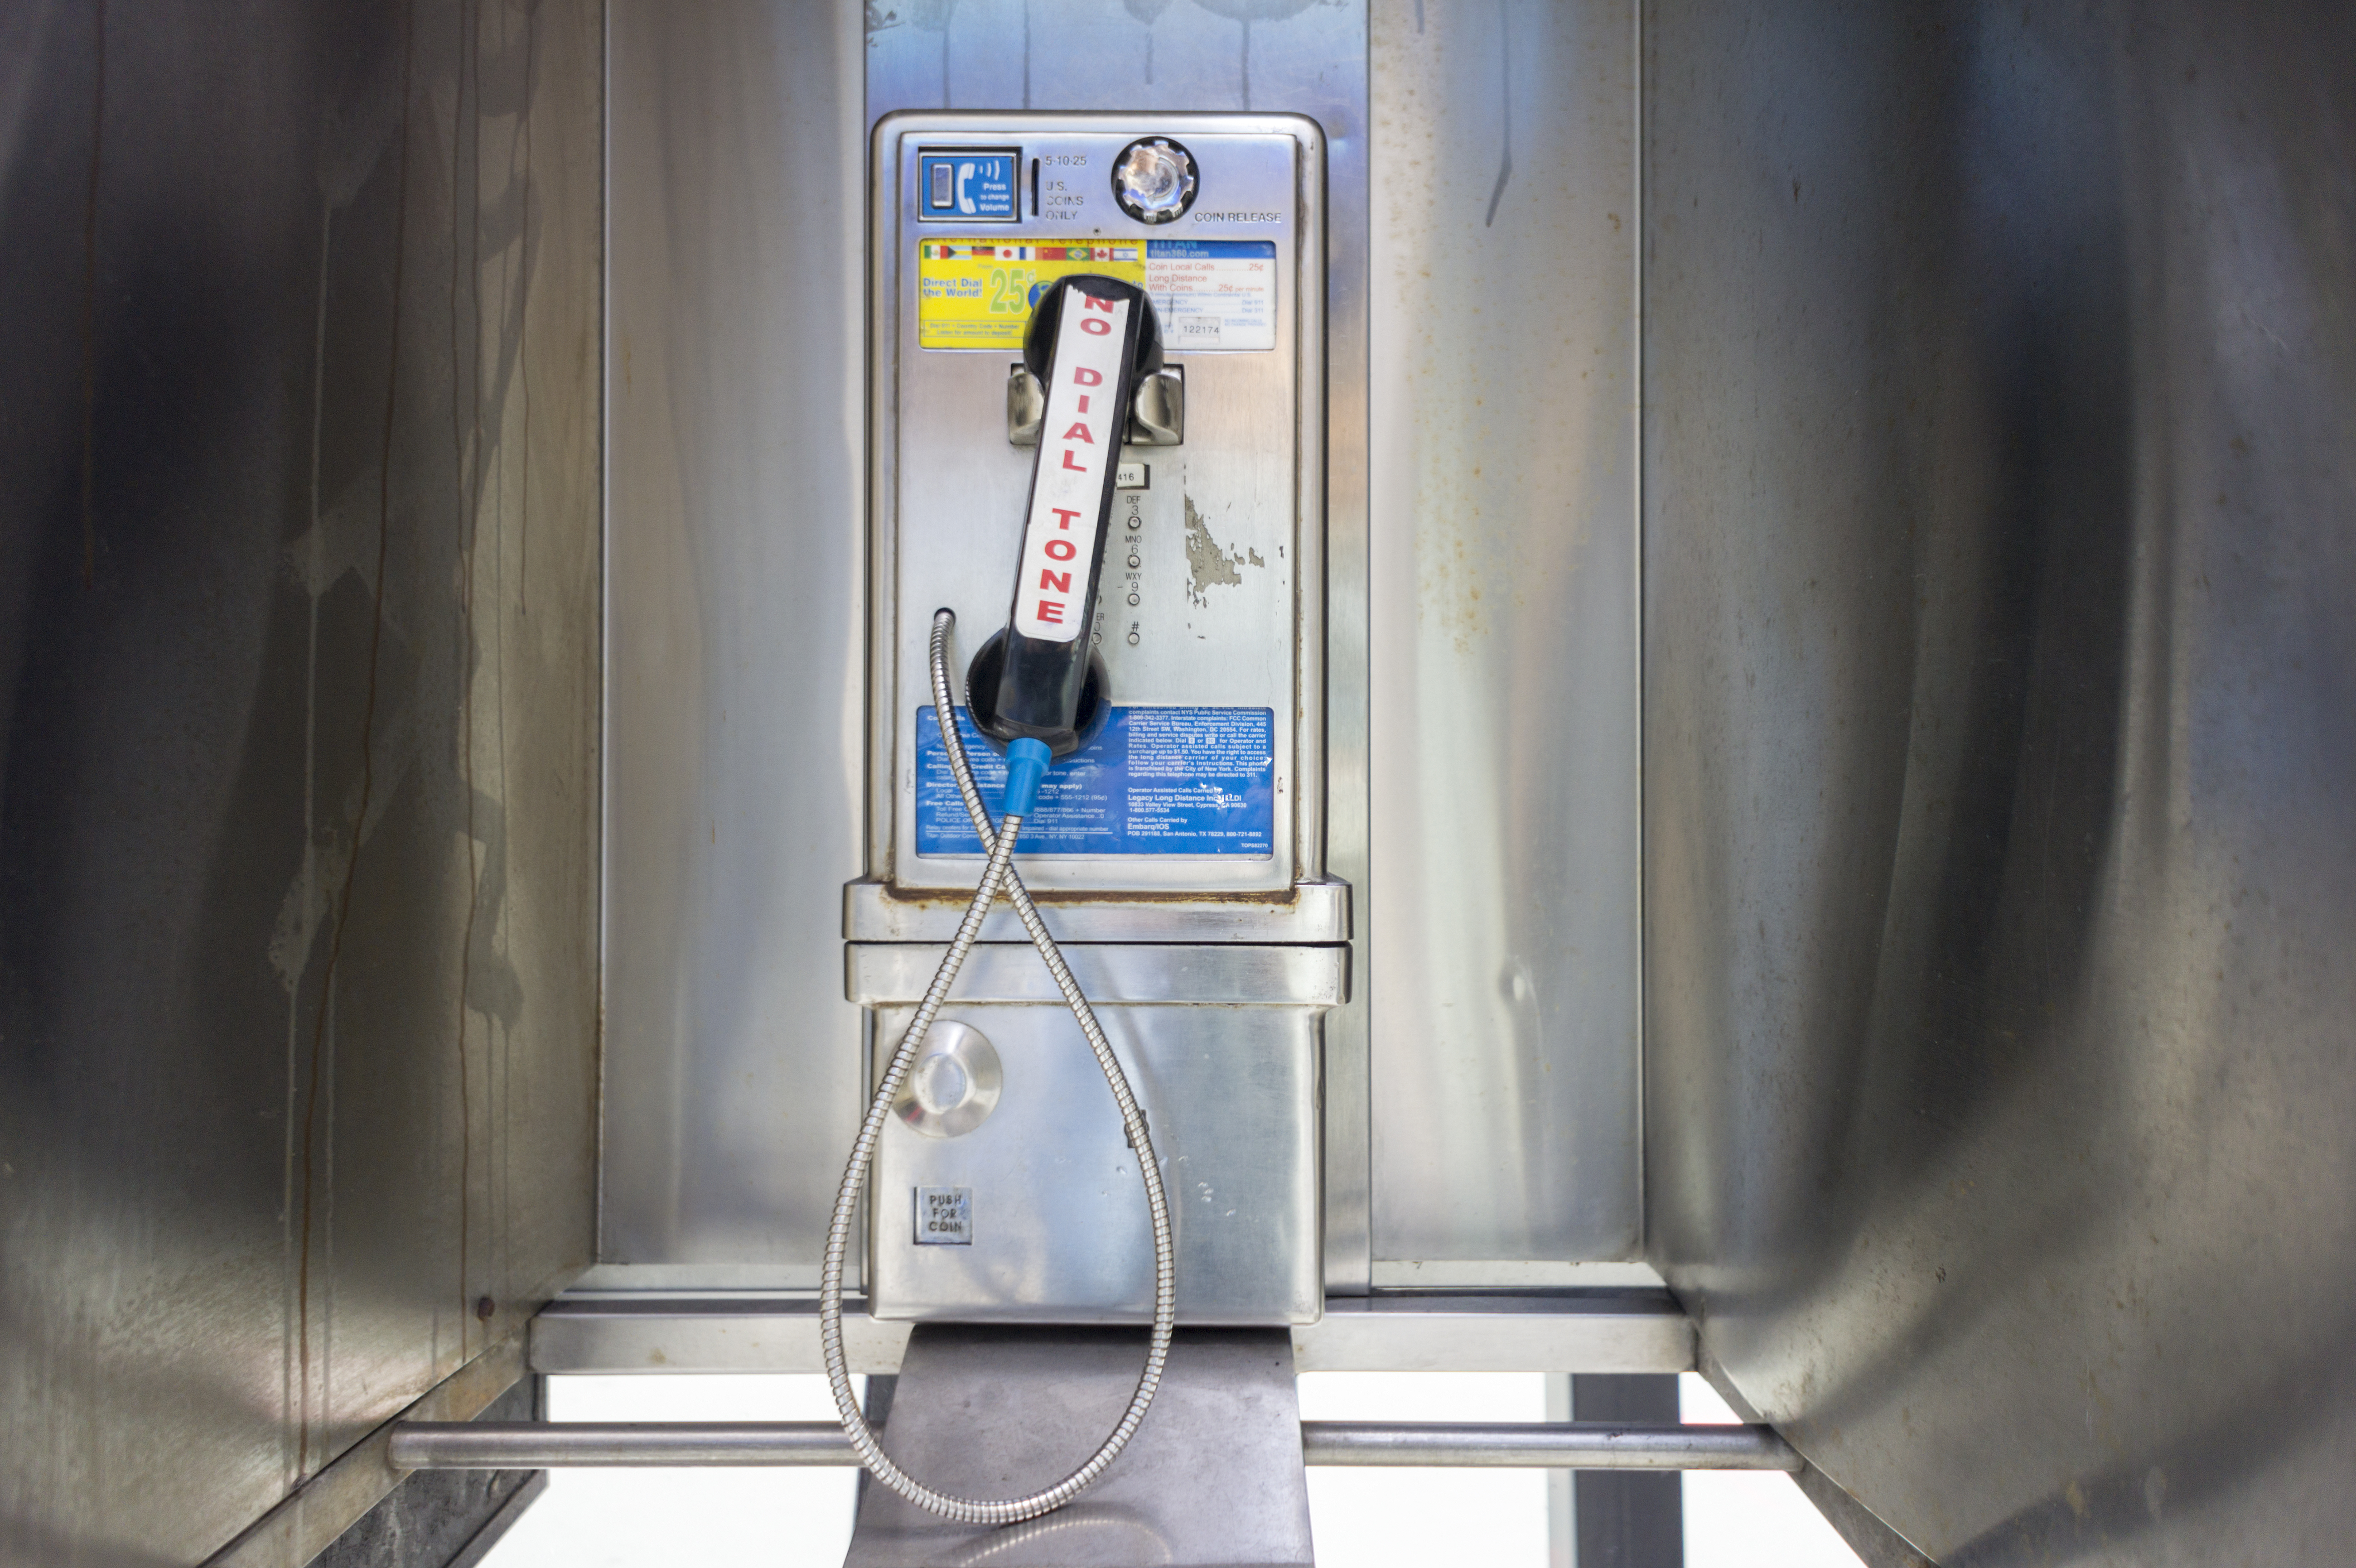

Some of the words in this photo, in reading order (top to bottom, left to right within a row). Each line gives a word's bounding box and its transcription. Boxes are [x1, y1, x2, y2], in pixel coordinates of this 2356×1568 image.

[1046, 182, 1067, 191] U.S.
[1046, 197, 1084, 205] COINS
[1046, 211, 1078, 220] ONLY
[1195, 213, 1224, 222] COIN
[1228, 213, 1282, 223] RELEASE
[1195, 263, 1215, 271] Calls
[923, 278, 956, 287] Direct
[961, 278, 982, 287] Dial
[1149, 275, 1169, 284] Long
[923, 288, 942, 297] the
[946, 288, 983, 297] World!
[1183, 325, 1219, 334] 122174
[1062, 366, 1103, 473] DIAL
[1127, 496, 1141, 504] DEF
[1132, 505, 1139, 516] 3
[1125, 535, 1142, 543] MNO
[1131, 544, 1139, 554] 6
[1037, 507, 1081, 624] TONE
[1125, 572, 1142, 580] WXY
[1131, 582, 1139, 592] 9
[929, 1194, 962, 1206] PUSH
[932, 1208, 957, 1219] FOR
[929, 1221, 962, 1232] COIN
